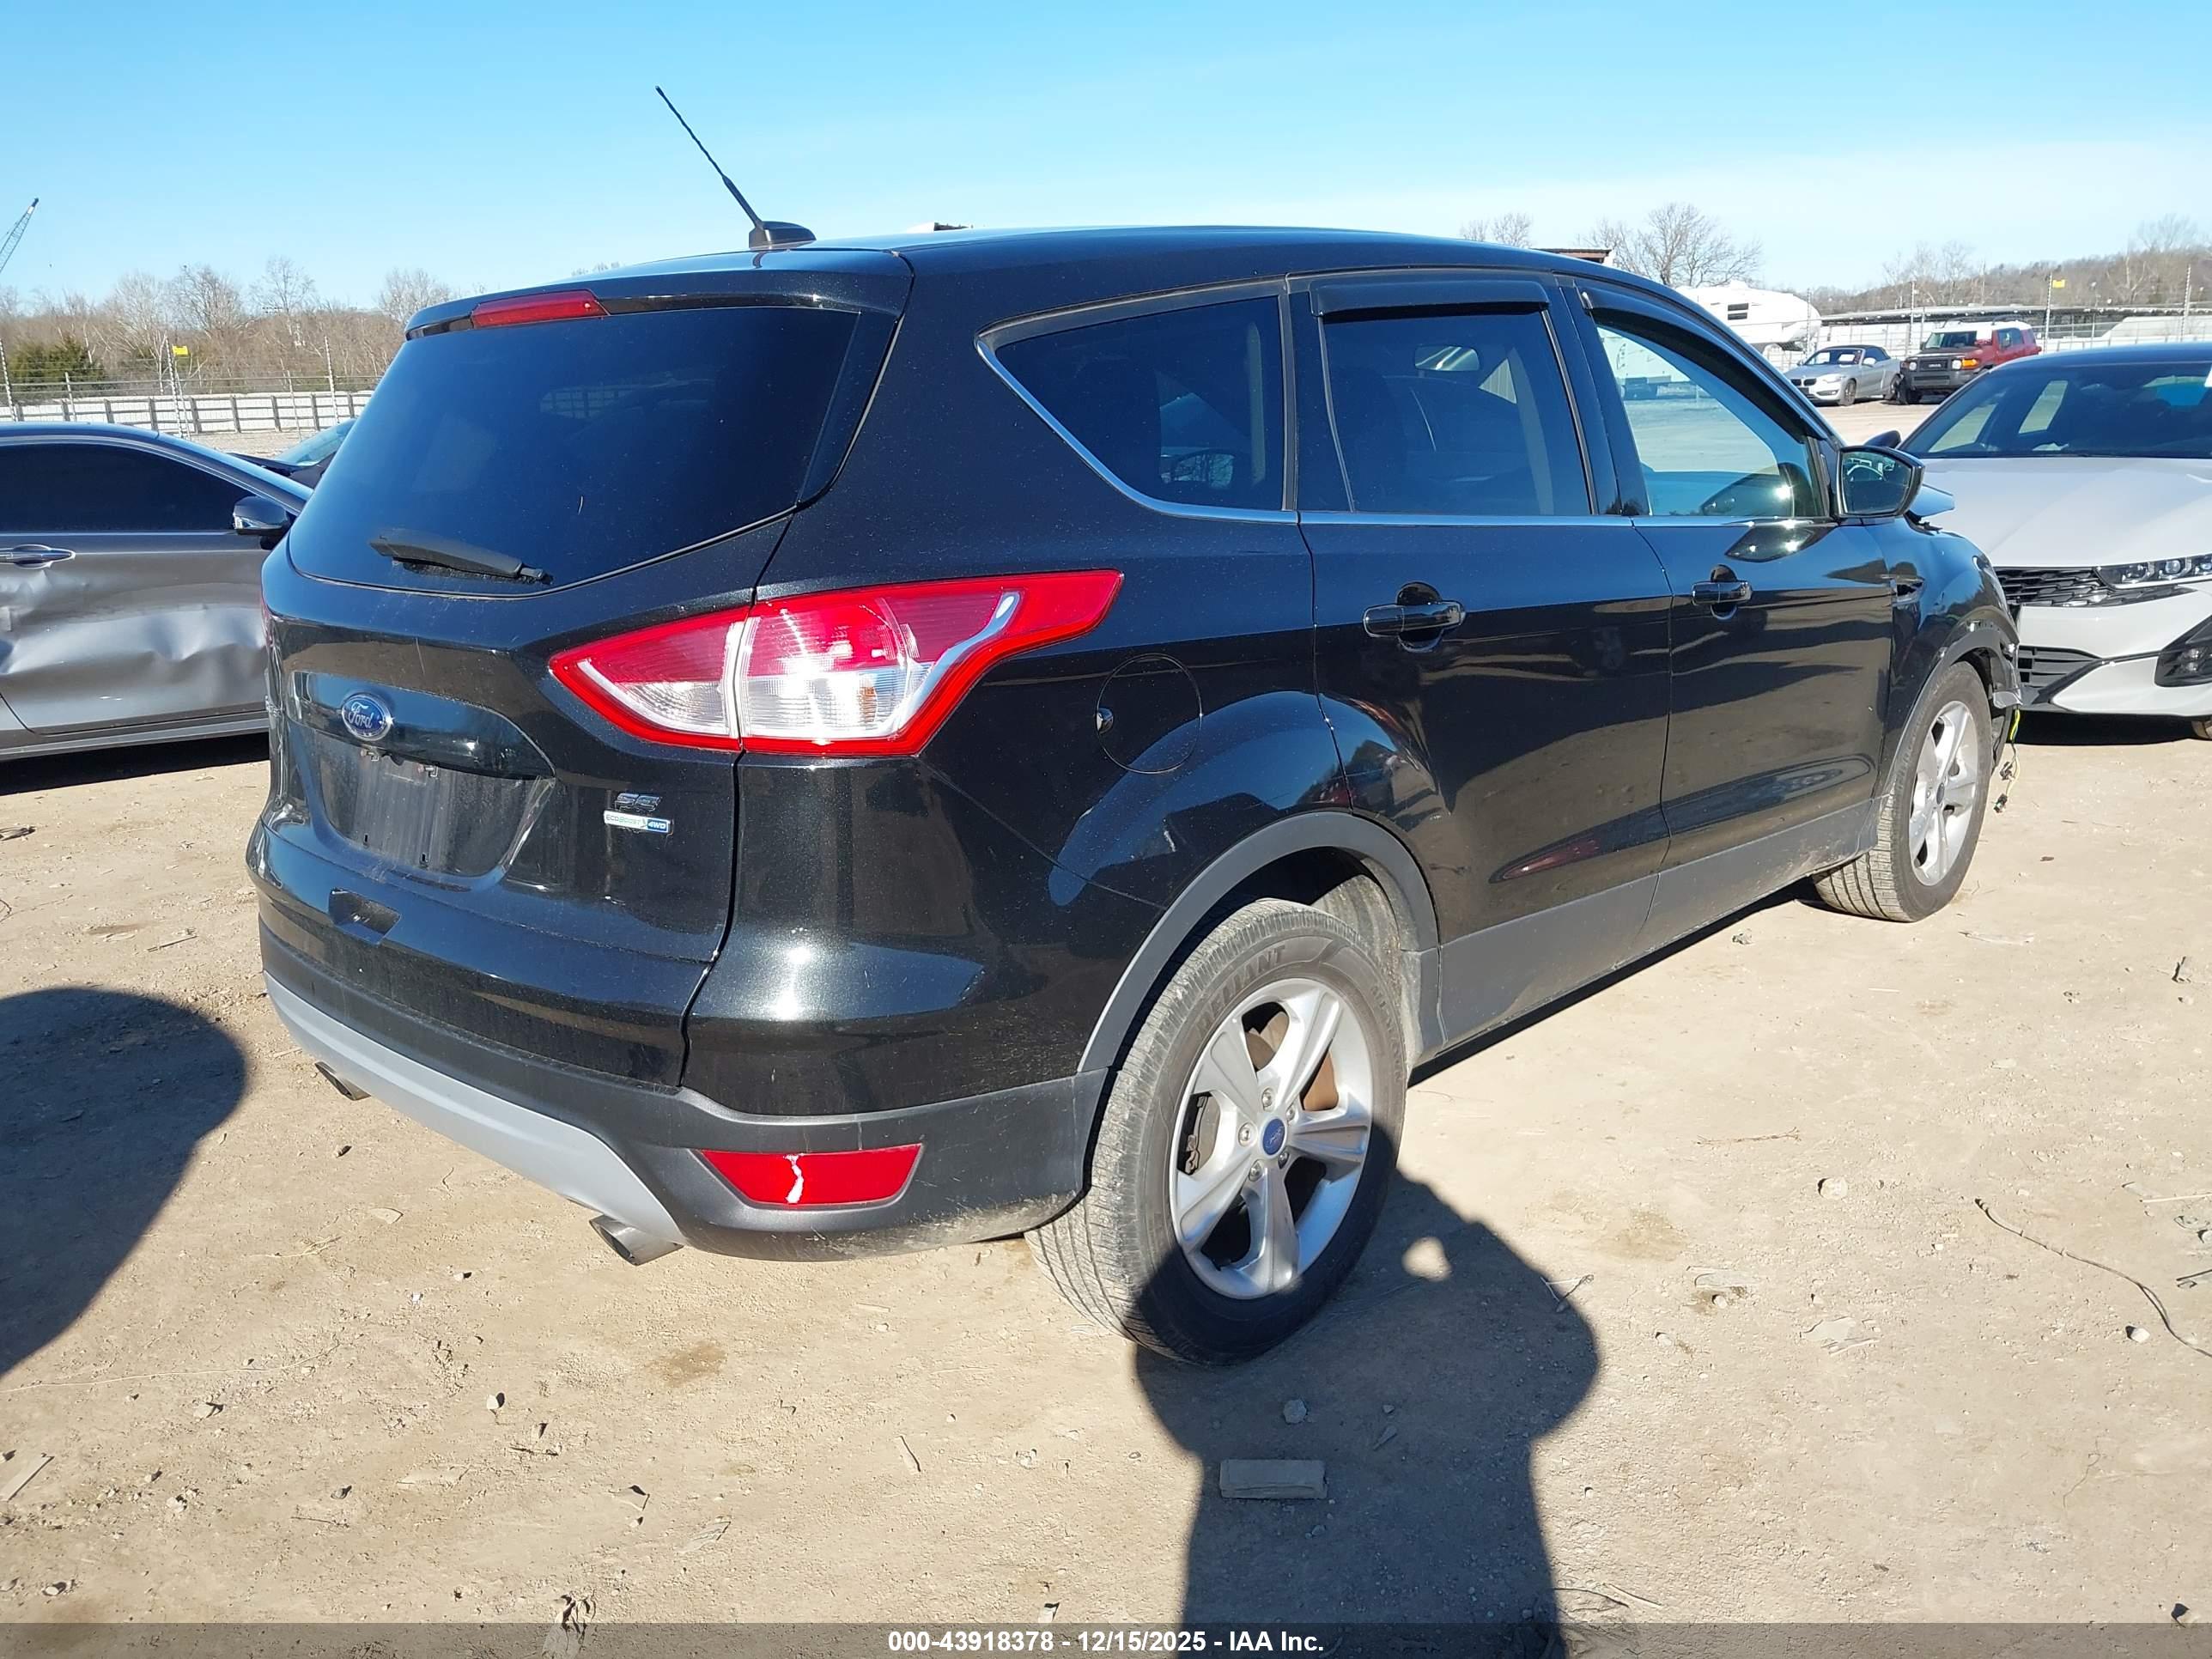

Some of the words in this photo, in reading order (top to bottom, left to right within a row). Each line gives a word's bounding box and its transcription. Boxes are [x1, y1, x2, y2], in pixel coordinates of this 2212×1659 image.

[348, 702, 374, 728] Ford
[615, 793, 660, 809] SE
[647, 821, 666, 830] 4WD
